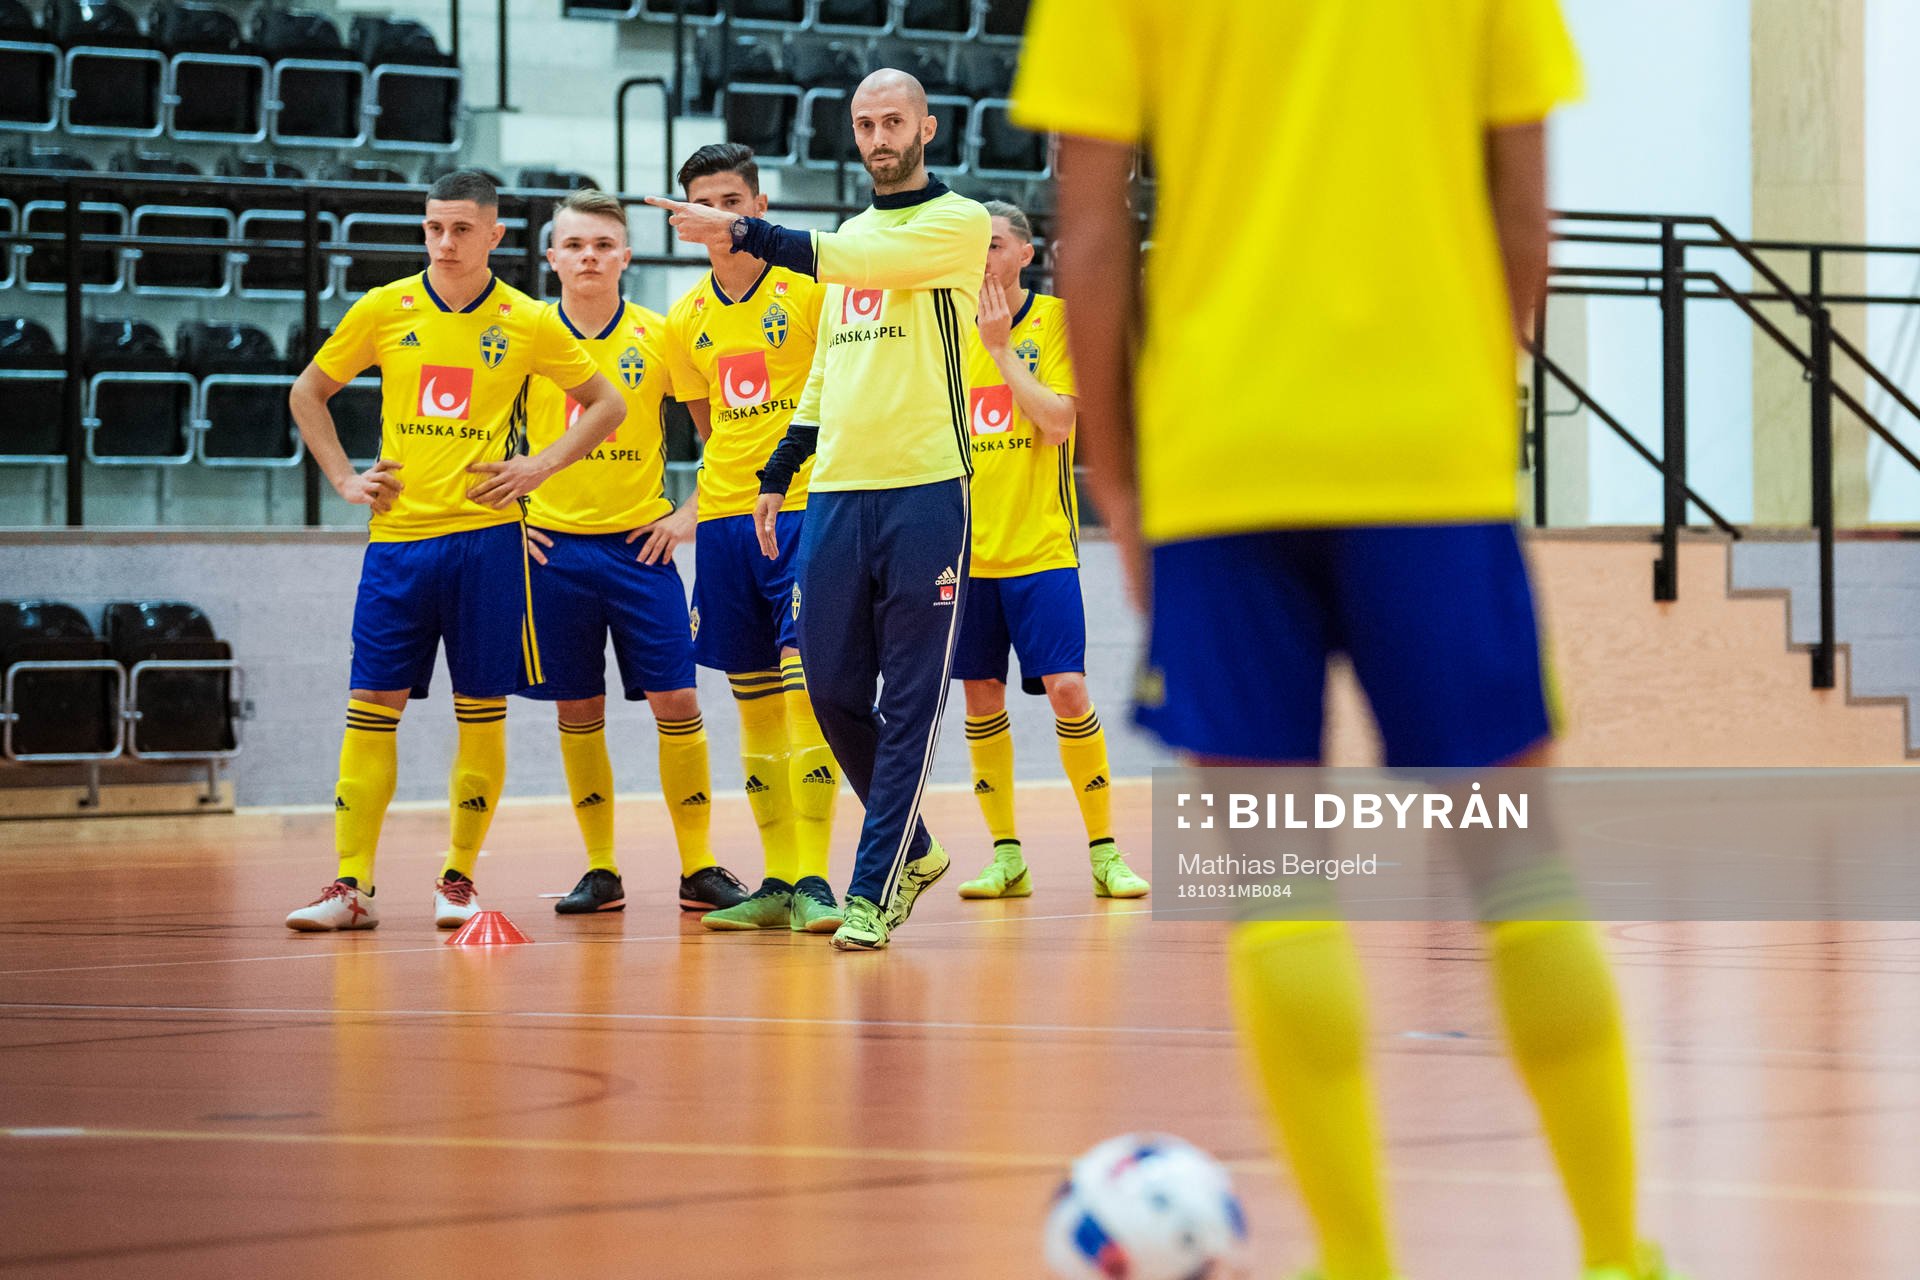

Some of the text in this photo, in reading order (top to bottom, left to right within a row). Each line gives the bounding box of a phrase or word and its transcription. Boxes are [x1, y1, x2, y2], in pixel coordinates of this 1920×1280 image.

[873, 325, 907, 338] SPEL
[761, 398, 798, 414] SPEL
[459, 427, 492, 441] SPEL
[971, 437, 1033, 453] NSKA SPE
[610, 449, 642, 461] SPEL
